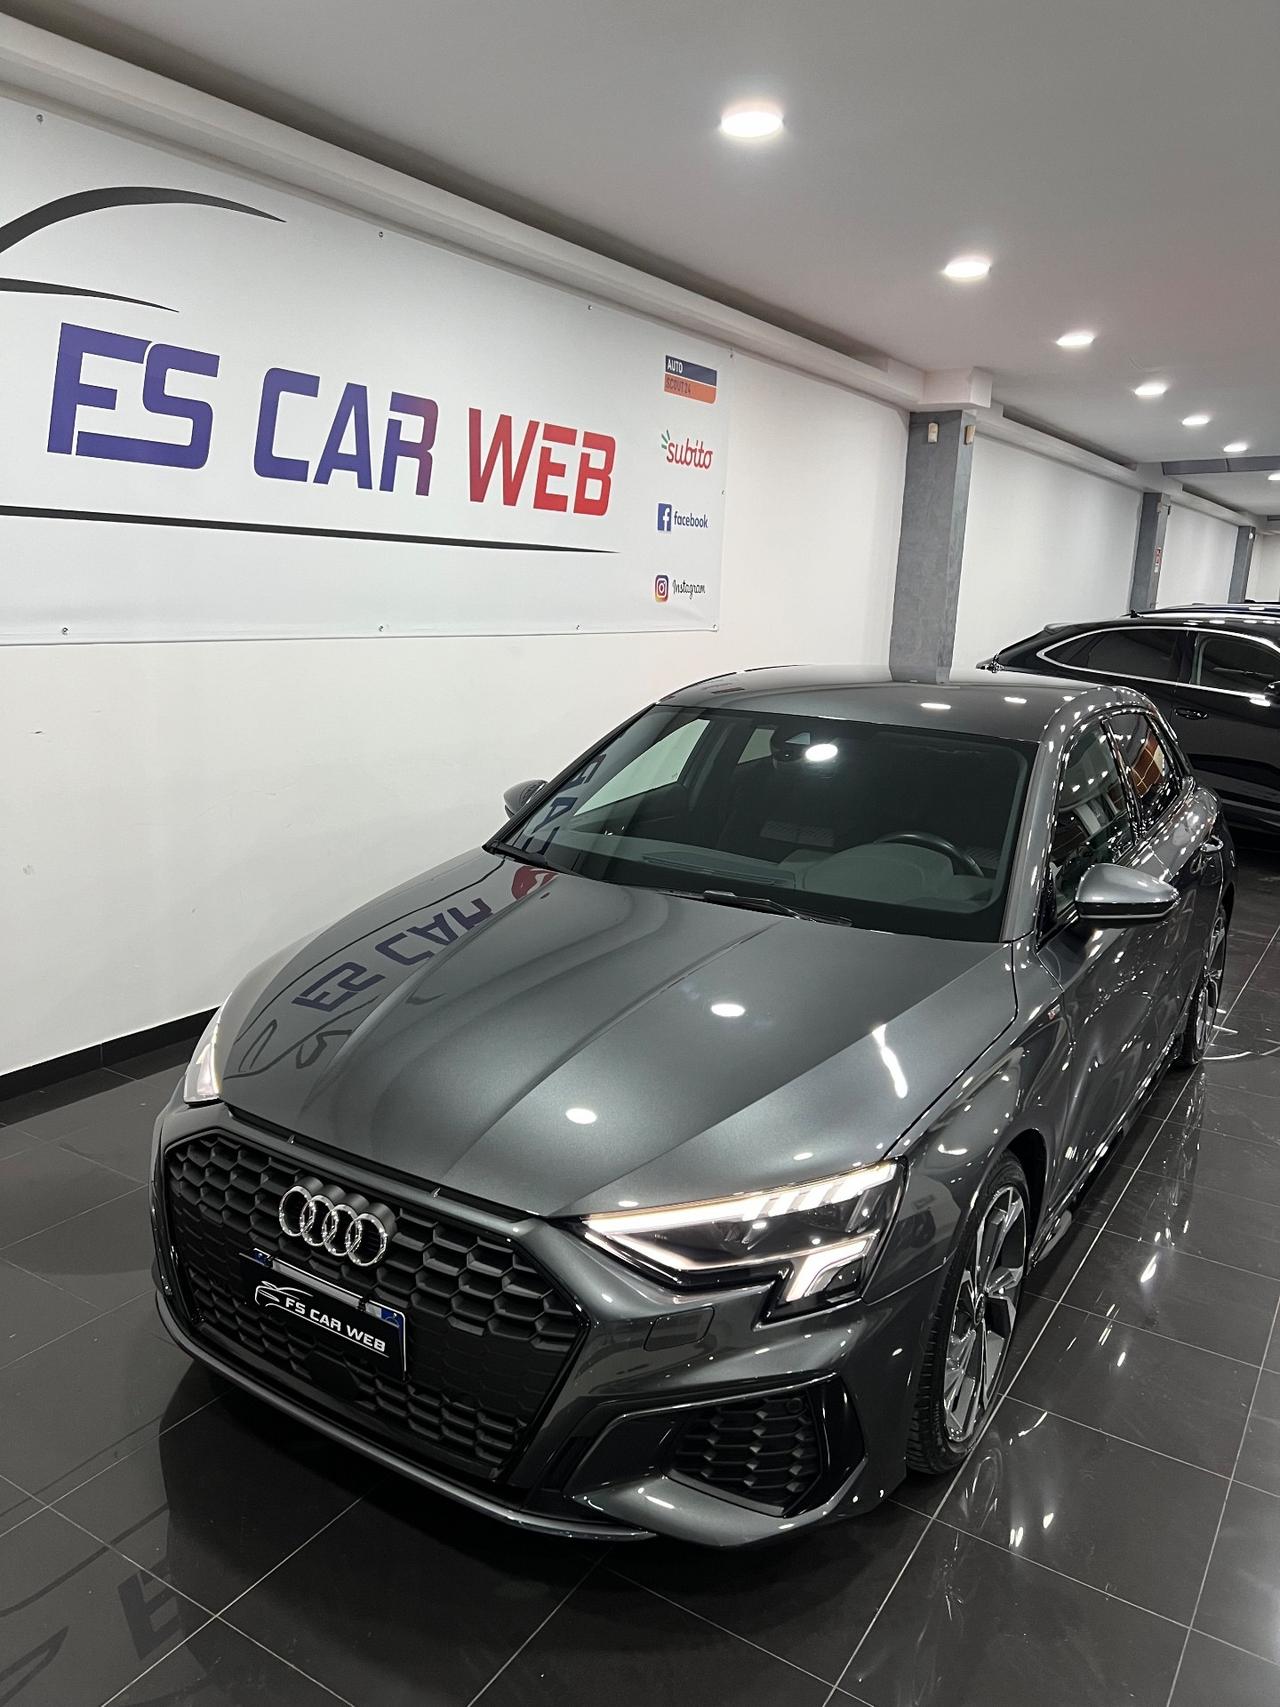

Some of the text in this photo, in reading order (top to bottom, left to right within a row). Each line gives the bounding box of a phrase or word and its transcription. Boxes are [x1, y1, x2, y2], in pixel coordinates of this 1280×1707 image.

[667, 358, 683, 373] AUTO
[254, 366, 439, 497] CAR
[467, 407, 617, 517] WEB
[666, 438, 713, 469] subito
[673, 510, 708, 528] facebook
[672, 579, 705, 600] Instagram
[285, 1298, 386, 1352] FS CAR WEB
